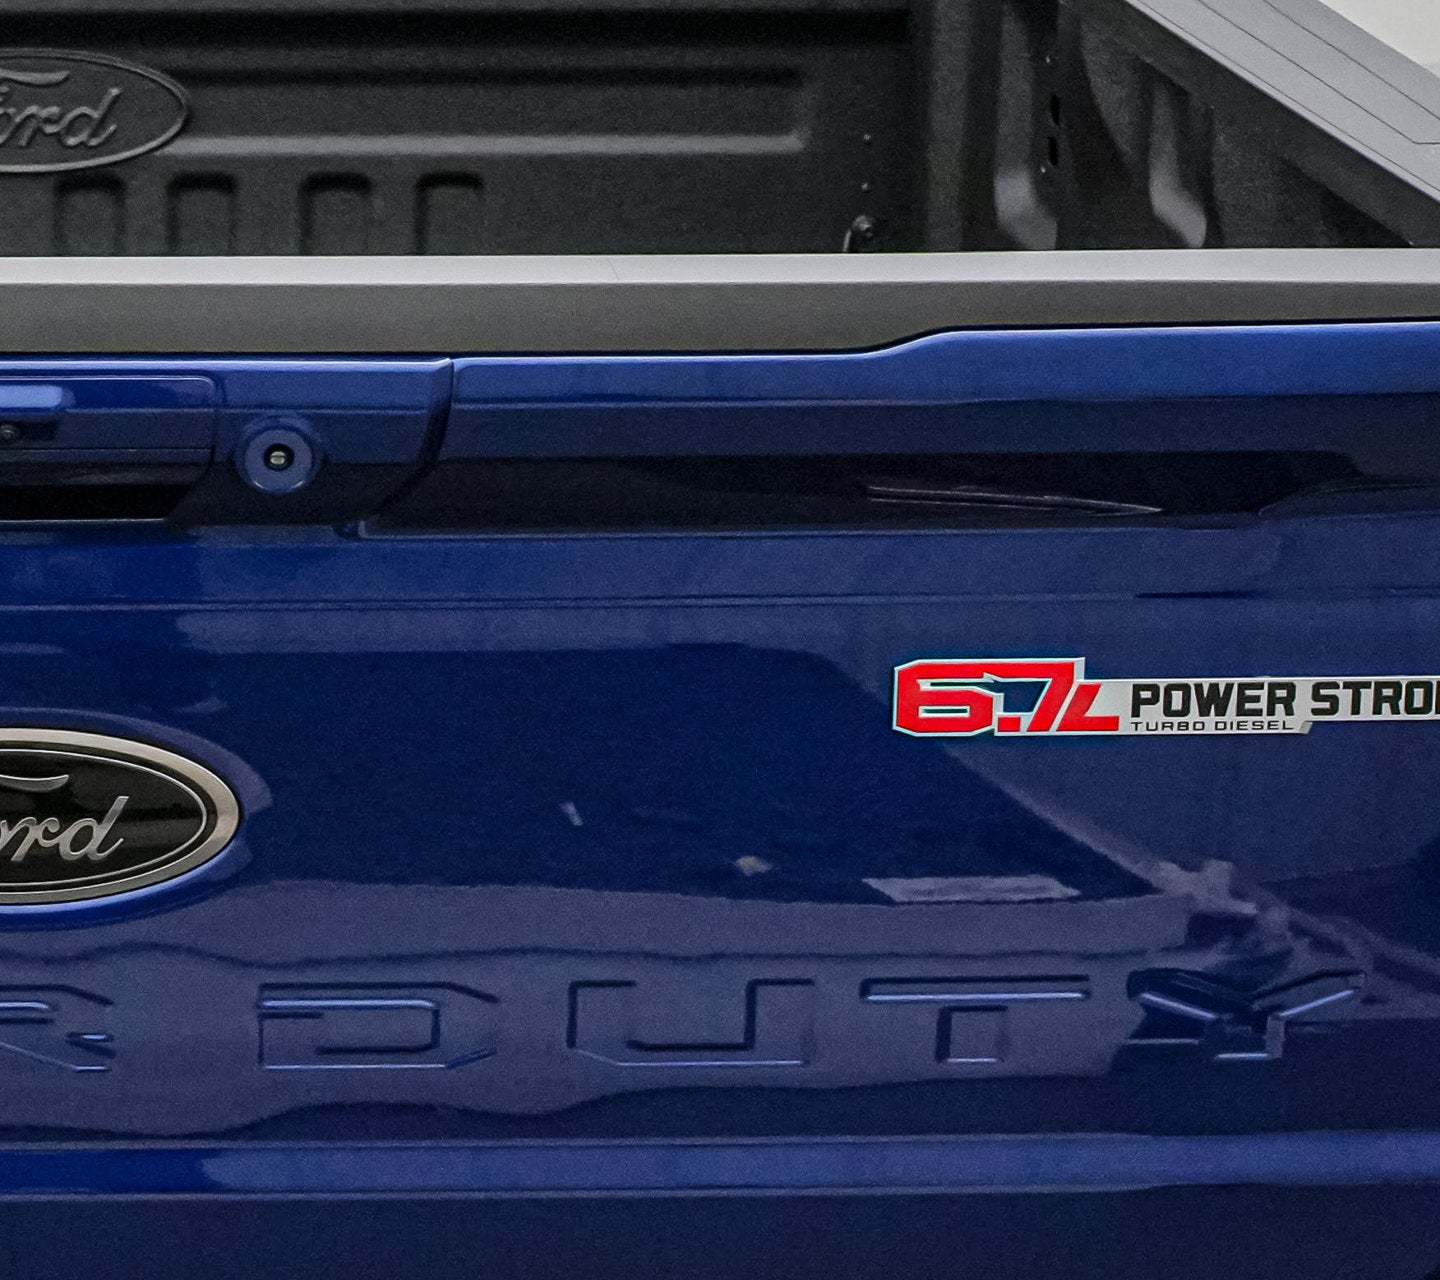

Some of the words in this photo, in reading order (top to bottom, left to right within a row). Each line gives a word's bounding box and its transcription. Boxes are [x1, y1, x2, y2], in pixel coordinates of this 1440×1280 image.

[893, 658, 1122, 736] 6.7L
[1130, 681, 1297, 718] POWER
[1130, 720, 1206, 732] TURBO
[1213, 720, 1295, 732] DIESEL
[257, 966, 1366, 1071] DUTY
